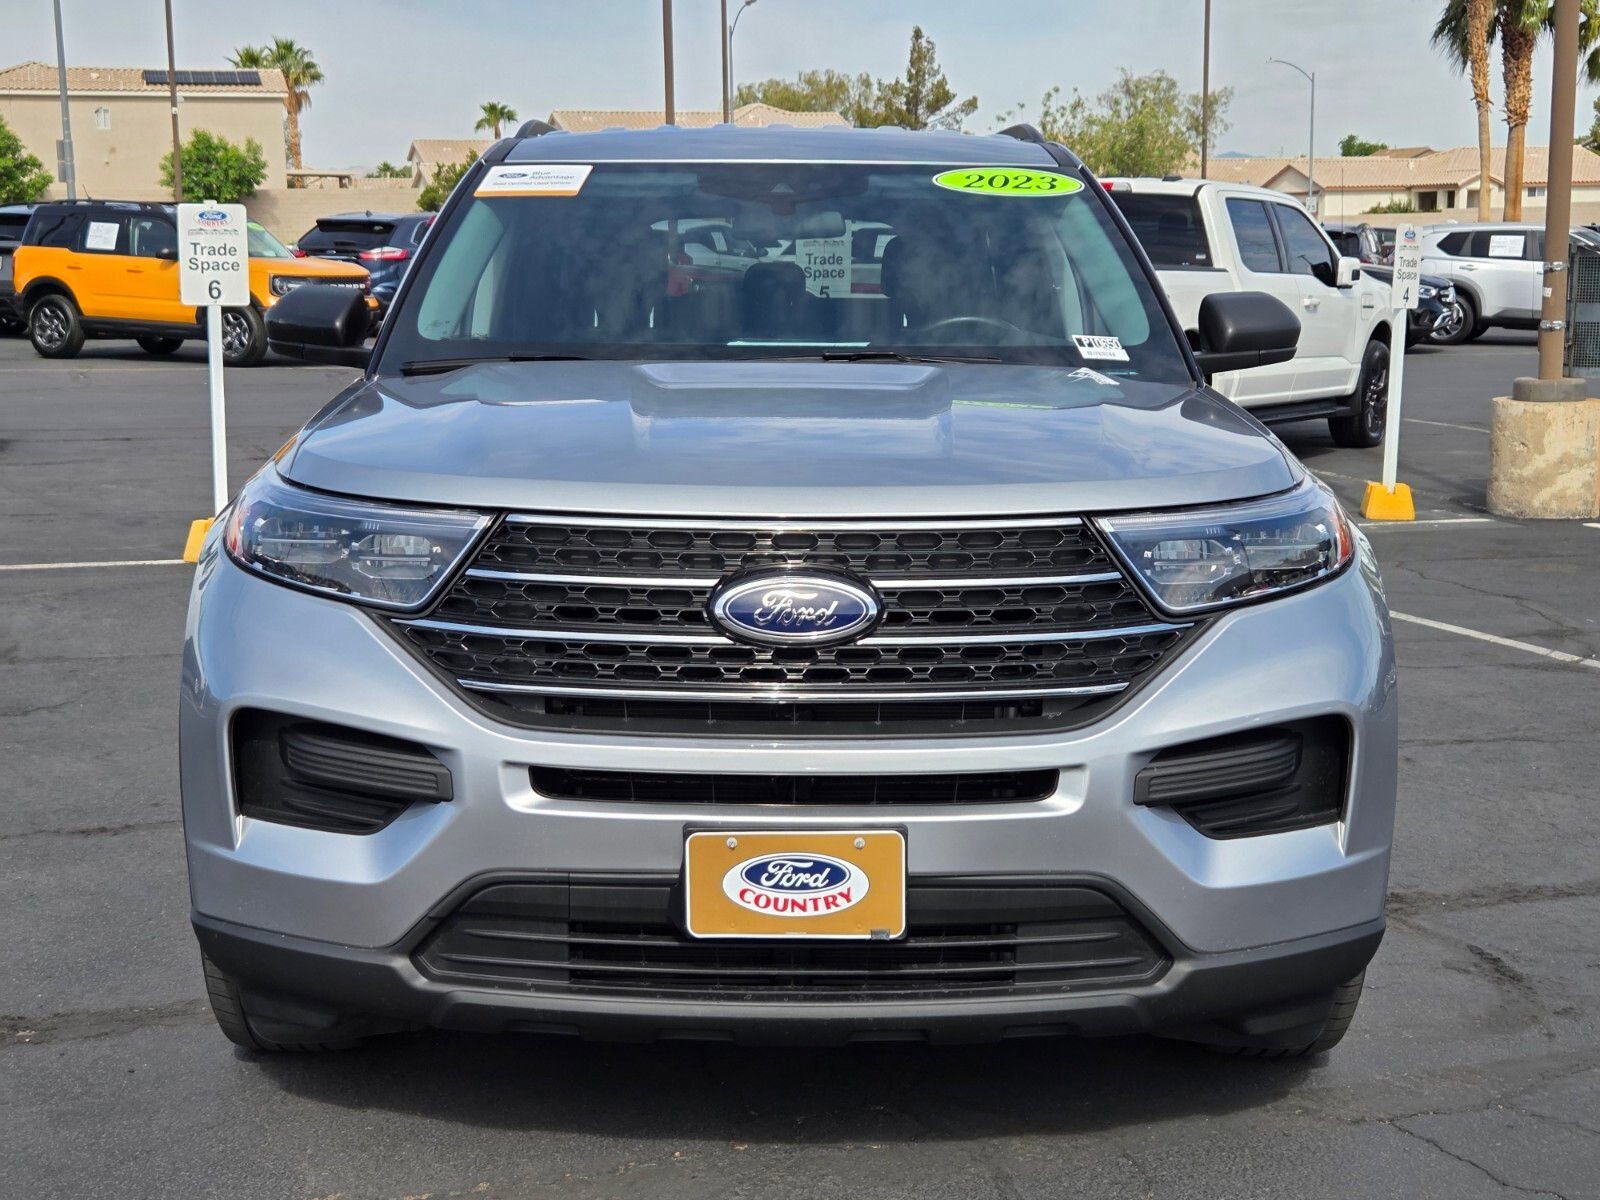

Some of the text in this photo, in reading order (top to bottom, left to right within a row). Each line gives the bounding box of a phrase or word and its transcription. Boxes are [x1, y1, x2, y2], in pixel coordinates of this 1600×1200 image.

[963, 174, 1058, 190] 2023
[190, 242, 237, 256] Trade
[188, 257, 240, 274] Space
[804, 252, 844, 265] Trade
[1399, 256, 1418, 268] Trade
[803, 266, 845, 281] Space
[1397, 269, 1418, 282] Space
[208, 280, 222, 300] 6
[819, 285, 830, 298] 5
[1402, 286, 1410, 303] 4
[753, 590, 839, 627] Ford
[760, 859, 831, 888] Ford
[739, 886, 853, 913] COUNTRY
